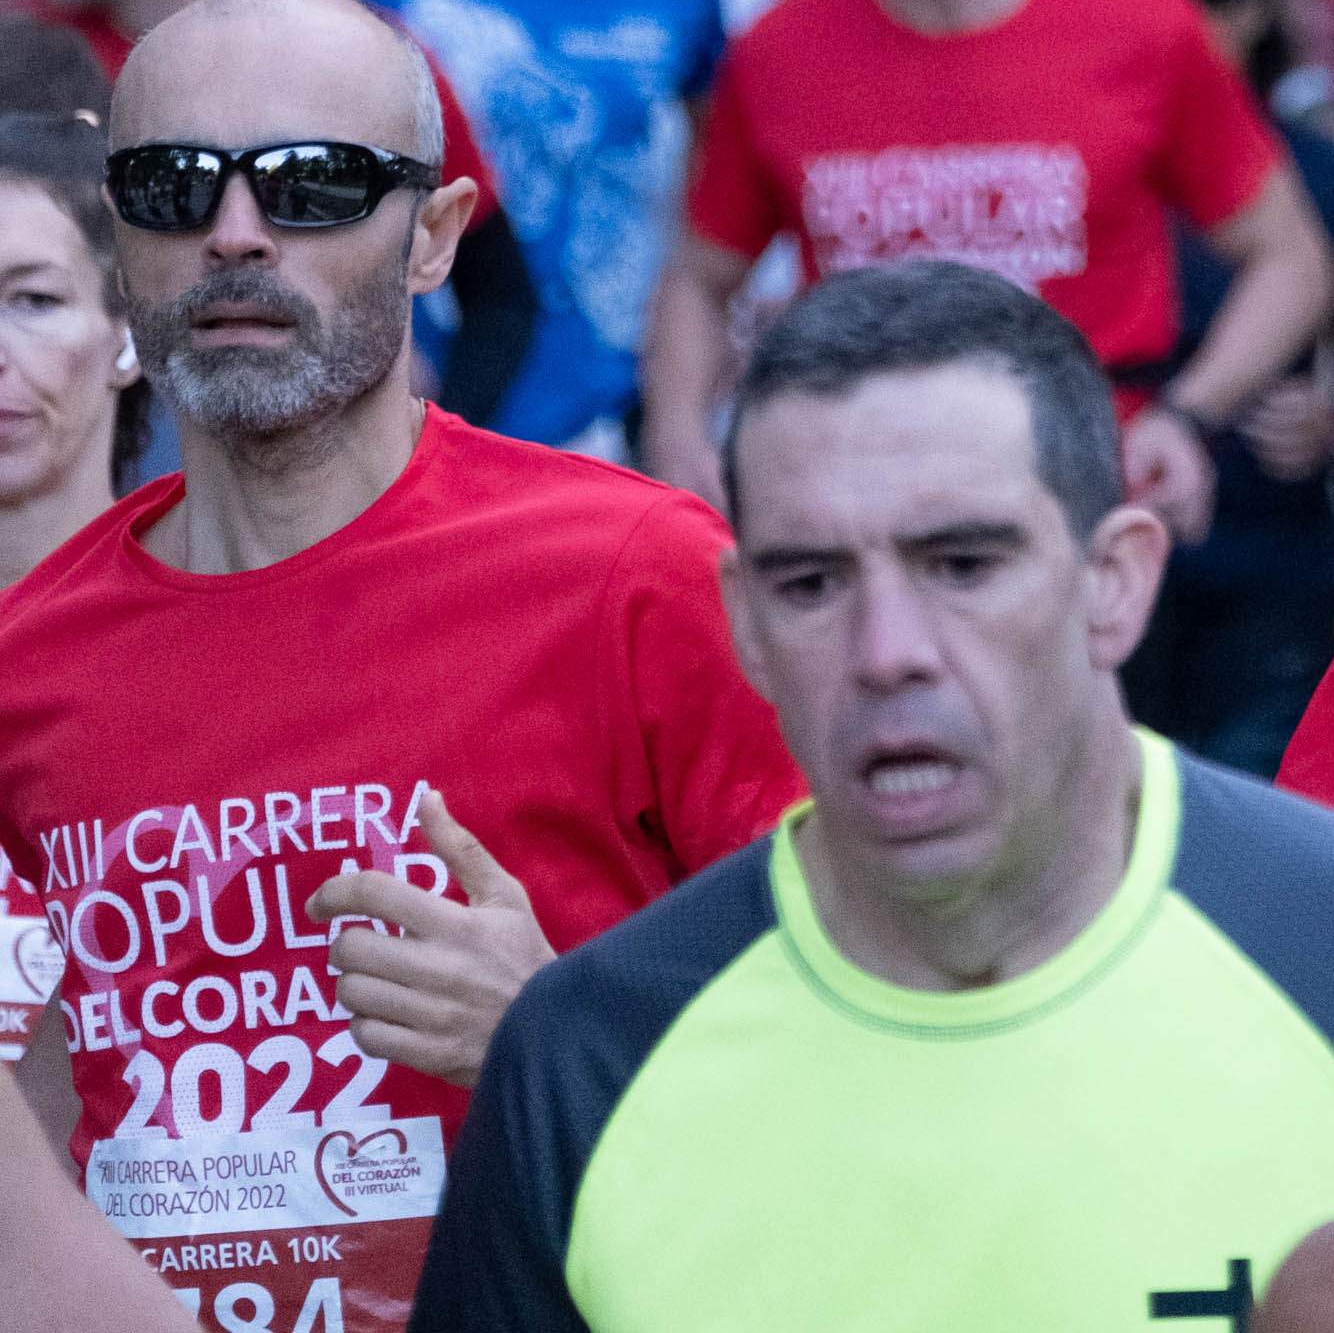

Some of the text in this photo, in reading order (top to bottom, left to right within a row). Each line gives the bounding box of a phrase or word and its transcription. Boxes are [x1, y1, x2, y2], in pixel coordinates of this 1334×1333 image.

[39, 819, 105, 893] XIII
[125, 780, 431, 873] CARRERA
[113, 1029, 392, 1138] 2022
[117, 1159, 198, 1184] CARRERA
[203, 1150, 298, 1181] POPULAR
[332, 1163, 421, 1184] DEL CORAZÓN
[105, 1184, 288, 1217] DEL CORAZÓN 2022
[357, 1182, 409, 1196] VIRTUAL
[287, 1234, 343, 1264] 10K
[172, 1276, 345, 1333] 84
